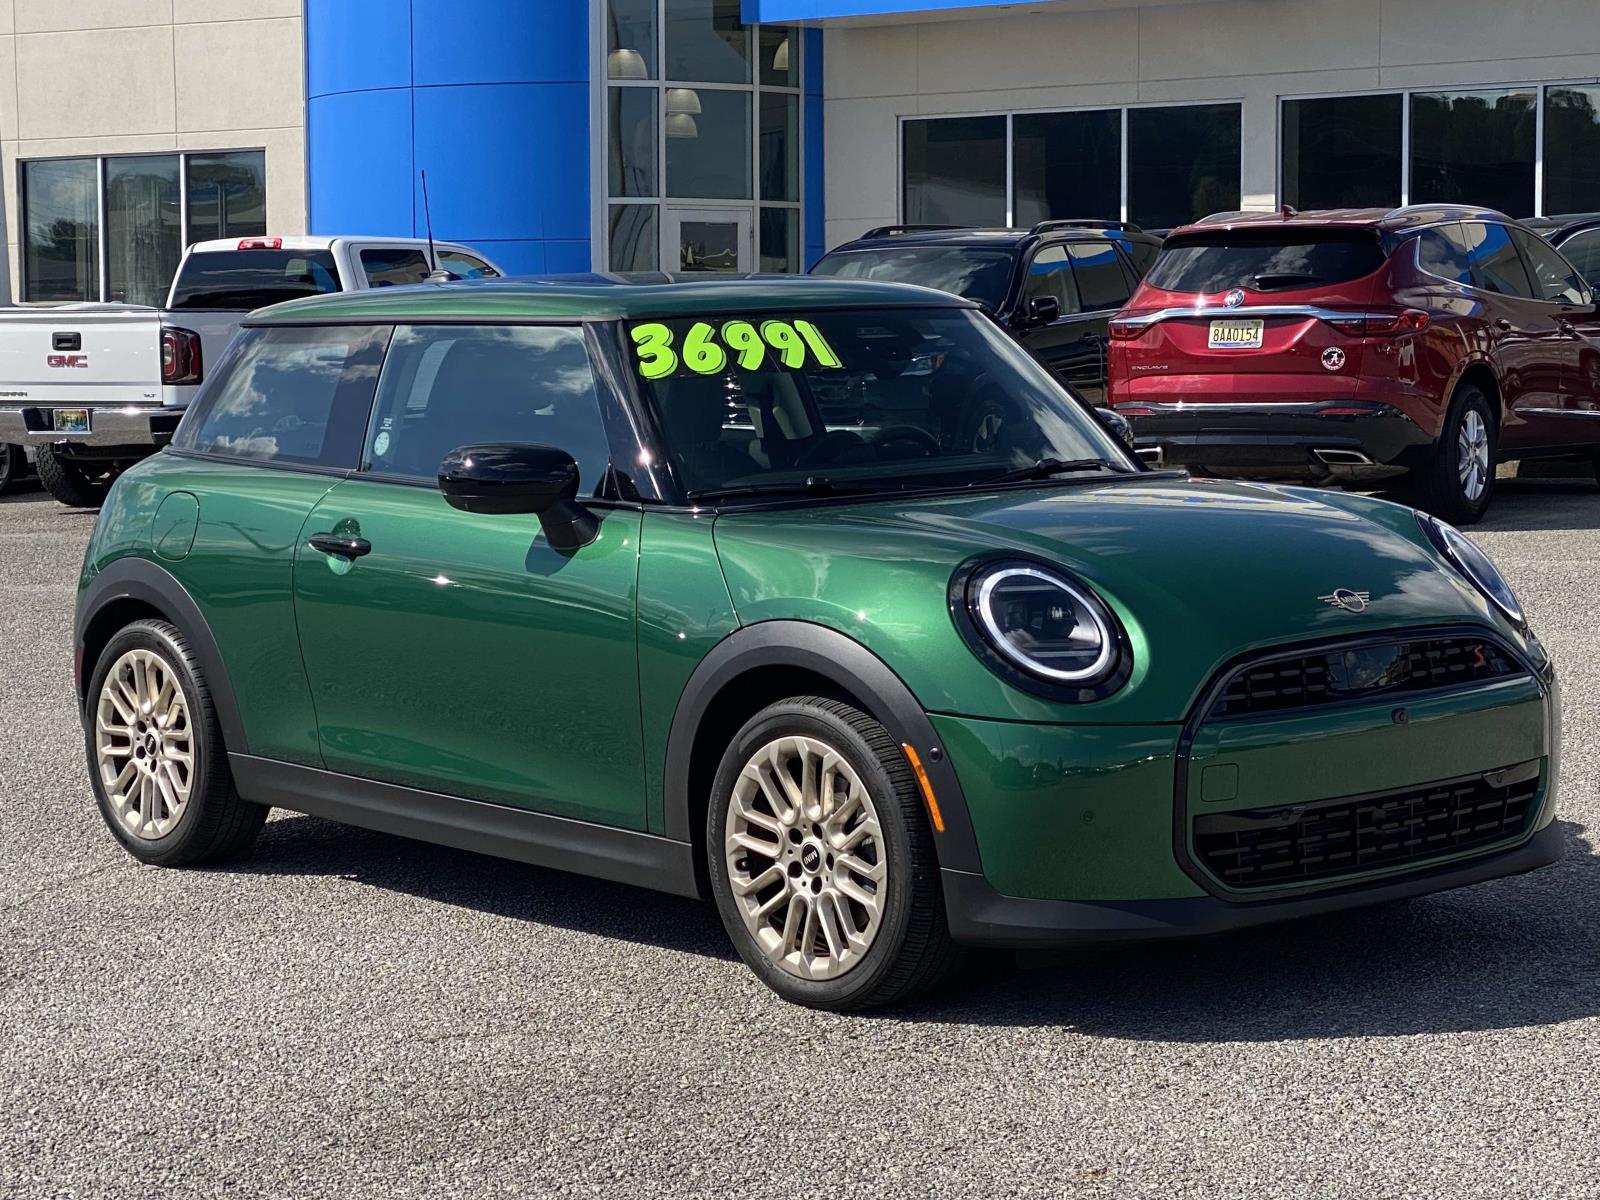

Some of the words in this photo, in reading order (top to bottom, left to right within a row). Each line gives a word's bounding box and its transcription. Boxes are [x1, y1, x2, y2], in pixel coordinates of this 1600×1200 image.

[1213, 328, 1259, 342] 8AA0154
[630, 320, 843, 379] 36991
[47, 355, 88, 368] GMC
[803, 849, 818, 865] MINI
